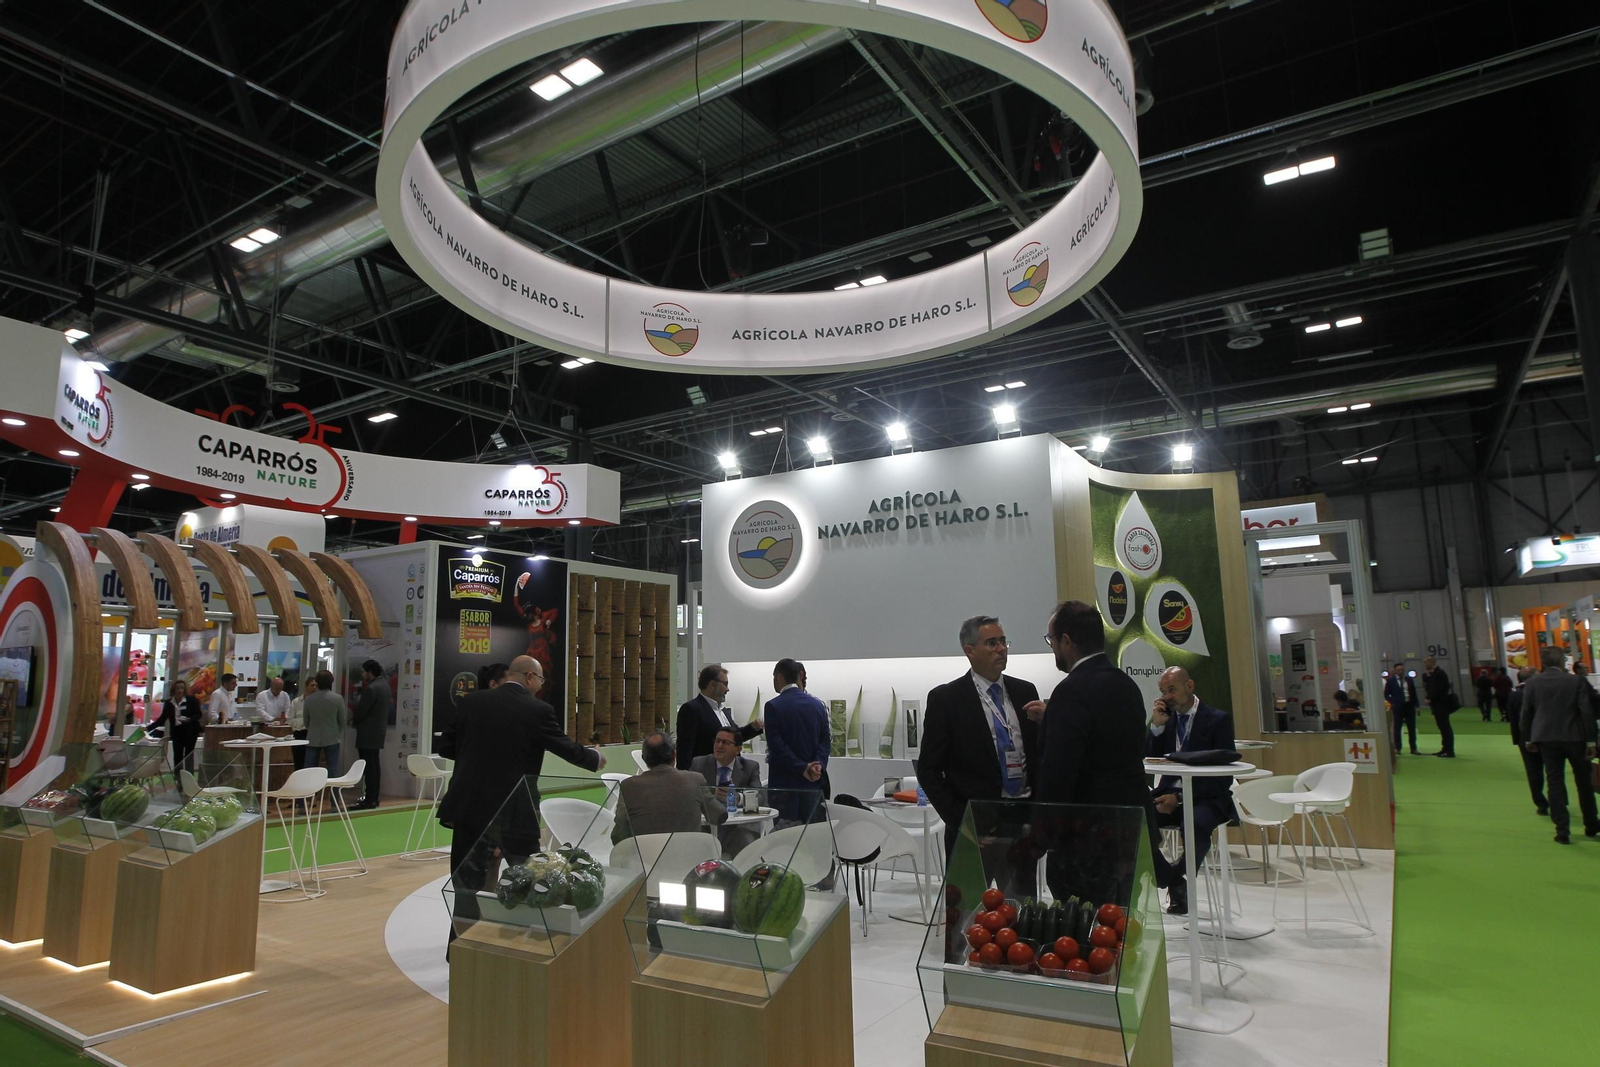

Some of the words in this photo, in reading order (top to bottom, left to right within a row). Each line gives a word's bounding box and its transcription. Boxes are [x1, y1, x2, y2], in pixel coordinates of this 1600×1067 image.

[402, 0, 470, 76] AGRÍCOLA
[1069, 194, 1108, 251] AGRÍCOLA
[409, 175, 443, 239] AGRÍCOLA
[446, 232, 499, 280] NAVARRO
[502, 274, 518, 292] DE
[521, 284, 559, 309] HARO
[562, 302, 585, 319] S.L.
[640, 310, 667, 320] NAVARRO
[732, 327, 808, 341] AGRÍCOLA
[814, 320, 884, 339] NAVARRO
[889, 315, 907, 329] DE
[911, 304, 951, 324] HARO
[954, 297, 977, 312] S.L.
[198, 434, 318, 475] CAPARRÓS
[196, 465, 245, 484] 1984-2019
[257, 469, 318, 489] NATURE
[342, 455, 355, 501] ANIVERSARIO
[484, 487, 551, 500] CAPARRÓS
[868, 488, 962, 514] AGRÍCOLA
[749, 519, 778, 527] AGRÍCOLA
[818, 516, 899, 539] NAVARRO
[906, 513, 929, 530] DE
[935, 506, 990, 526] HARO
[996, 502, 1029, 519] S.L.
[733, 528, 760, 536] NAVARRO
[453, 569, 500, 584] Caparrós
[465, 611, 490, 623] SABOR
[460, 638, 491, 653] 2019
[1427, 645, 1447, 657] 9b
